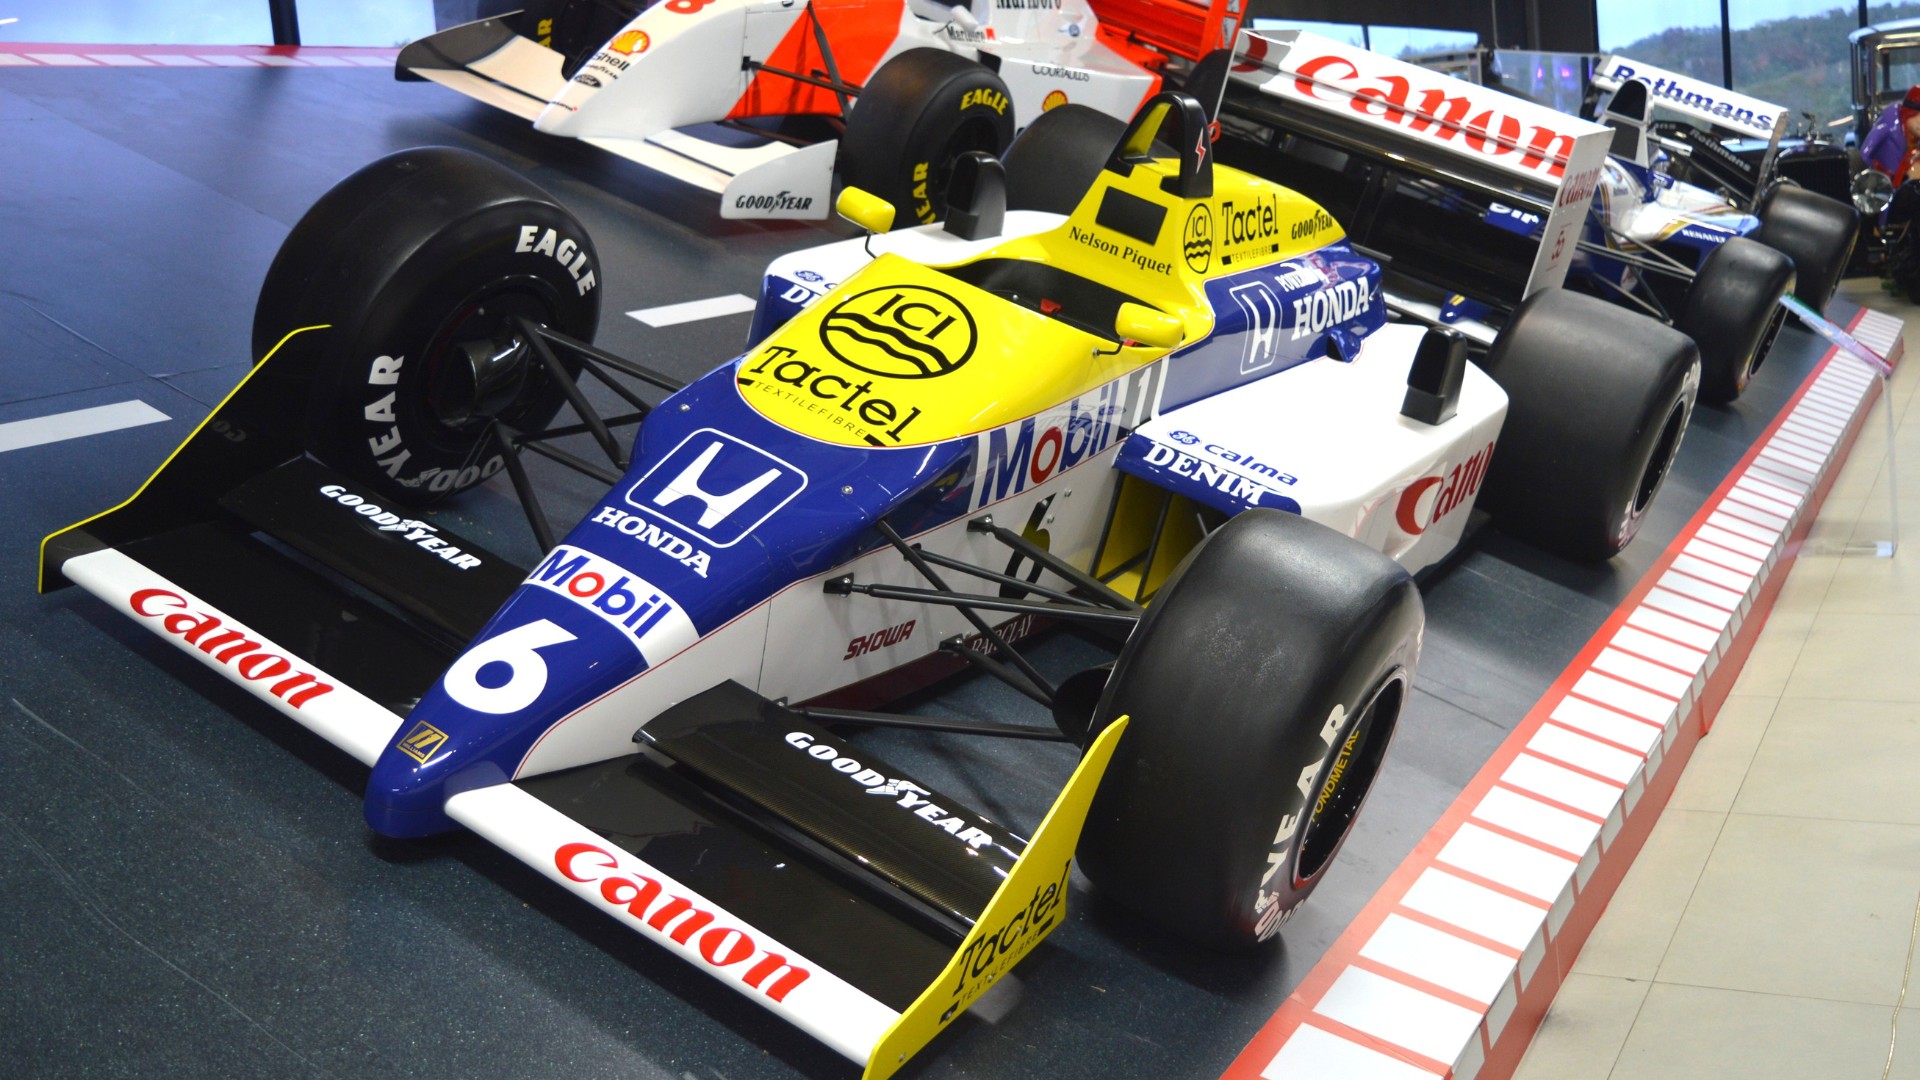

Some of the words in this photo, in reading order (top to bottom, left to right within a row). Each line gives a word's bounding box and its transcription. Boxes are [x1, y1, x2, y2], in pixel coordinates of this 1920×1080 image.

[961, 88, 1008, 116] EAGLE
[1295, 55, 1576, 178] Canon
[1690, 129, 1752, 172] Rothmans
[736, 190, 812, 213] GOODYEAR
[1191, 214, 1208, 238] ICI
[1222, 194, 1279, 246] Tactel
[1291, 210, 1333, 240] GOODYEAR
[515, 224, 595, 297] EAGLE
[1069, 226, 1119, 256] Nelson
[1122, 247, 1173, 276] Piquet
[872, 293, 958, 340] ICI
[1291, 276, 1369, 340] HONDA
[749, 345, 922, 443] Tactel
[755, 381, 866, 438] TEXTILEFIBRE
[978, 378, 1121, 508] Mobil
[1142, 441, 1267, 506] DENIM
[320, 484, 482, 570] GOODYEAR
[591, 505, 713, 578] HONDA
[529, 548, 673, 641] Mobil
[129, 588, 334, 710] Canon
[443, 618, 578, 714] 6
[843, 619, 917, 661] SHOWA
[784, 731, 993, 851] GOODYEAR
[554, 842, 811, 1004] Canon
[952, 858, 1072, 998] Tactel
